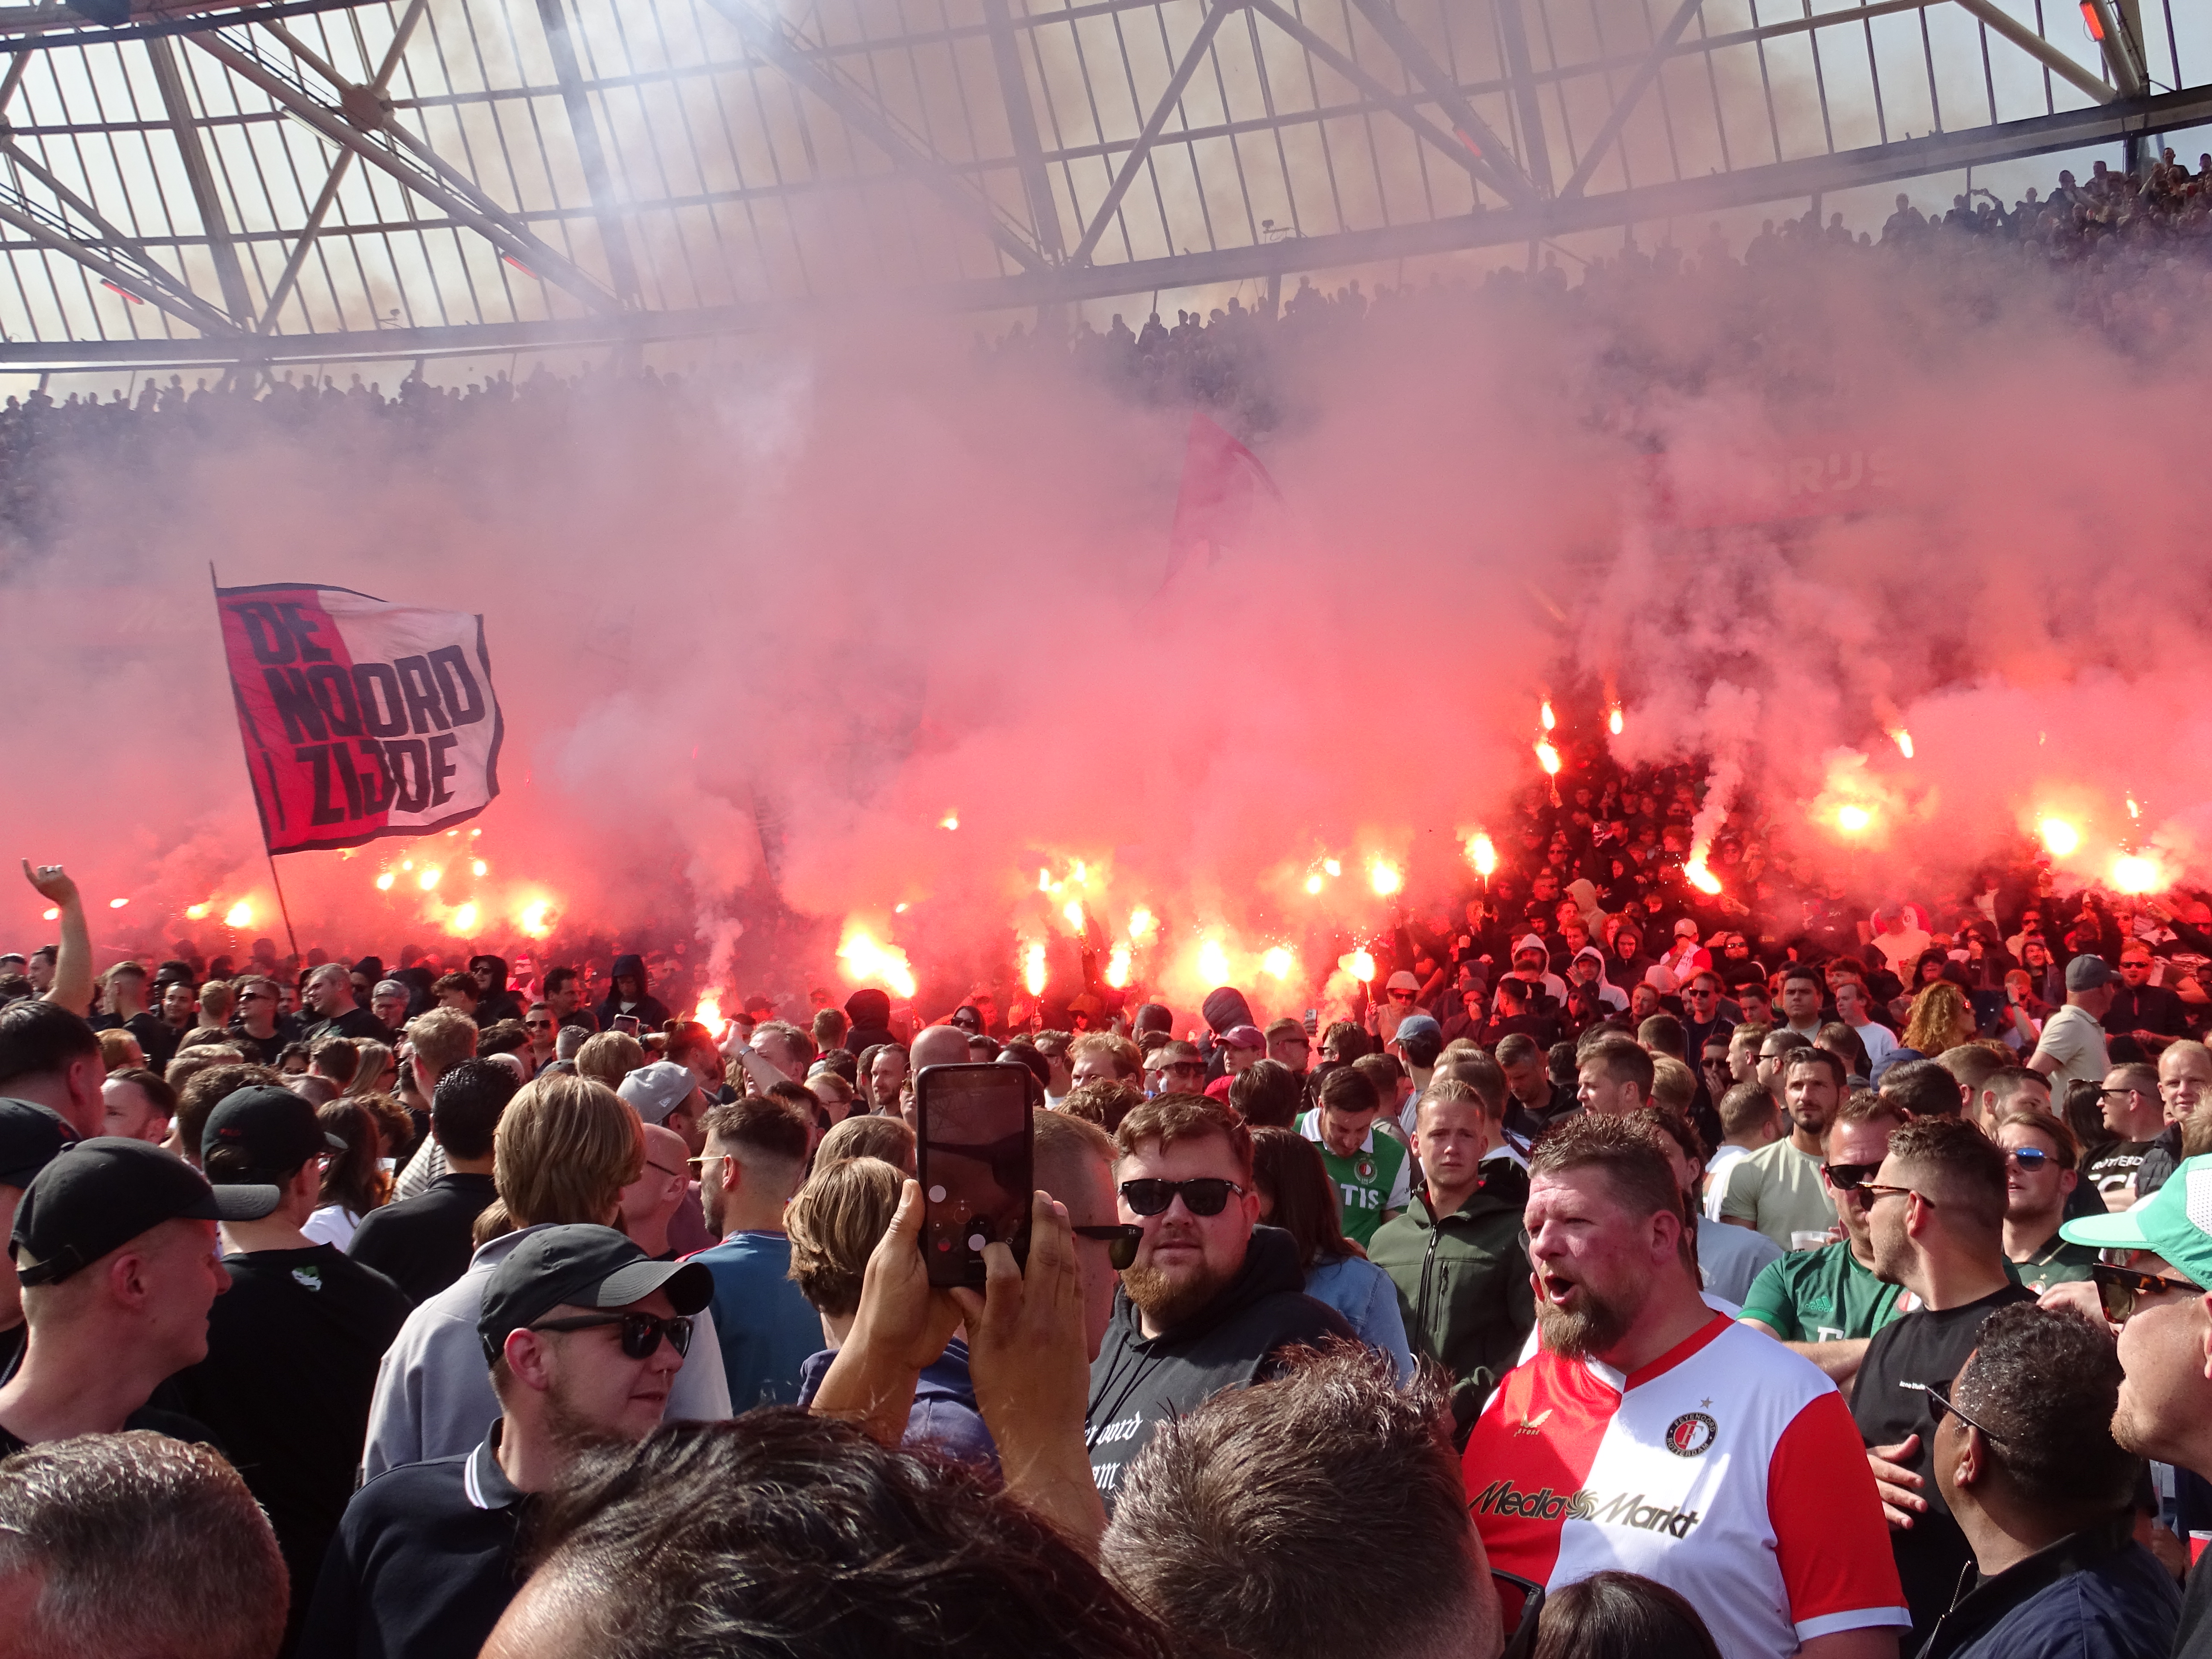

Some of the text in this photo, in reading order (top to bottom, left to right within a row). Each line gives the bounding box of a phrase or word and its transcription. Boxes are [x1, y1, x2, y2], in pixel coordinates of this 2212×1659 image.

[227, 602, 332, 665] DE
[263, 645, 485, 744] NOORD
[296, 732, 458, 827] ZIJDE
[2091, 1155, 2144, 1170] ROTTERD
[1341, 1183, 1379, 1209] TIS
[1674, 1413, 1716, 1432] FEYENOORD
[1667, 1438, 1709, 1456] ROTTERDAM
[1468, 1480, 1700, 1540] Media Markt
